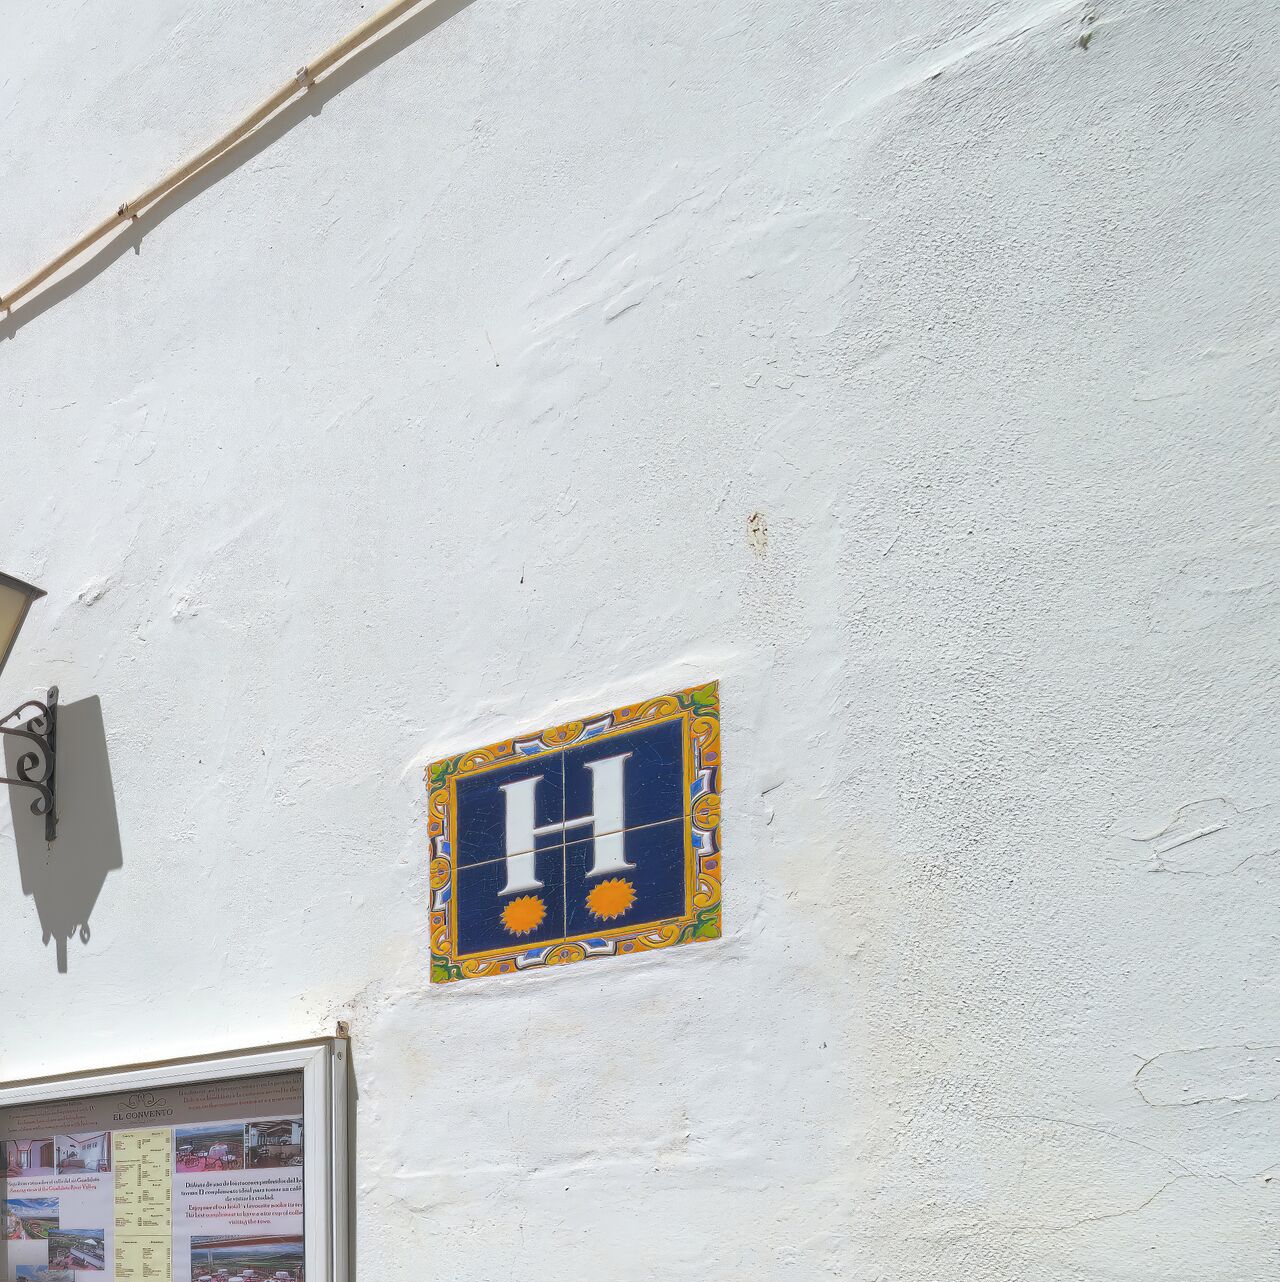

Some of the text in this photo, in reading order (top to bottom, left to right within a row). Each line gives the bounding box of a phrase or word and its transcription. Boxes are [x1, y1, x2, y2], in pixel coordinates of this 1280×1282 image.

[497, 751, 637, 897] H
[113, 1107, 174, 1121] EL CONVENTO
